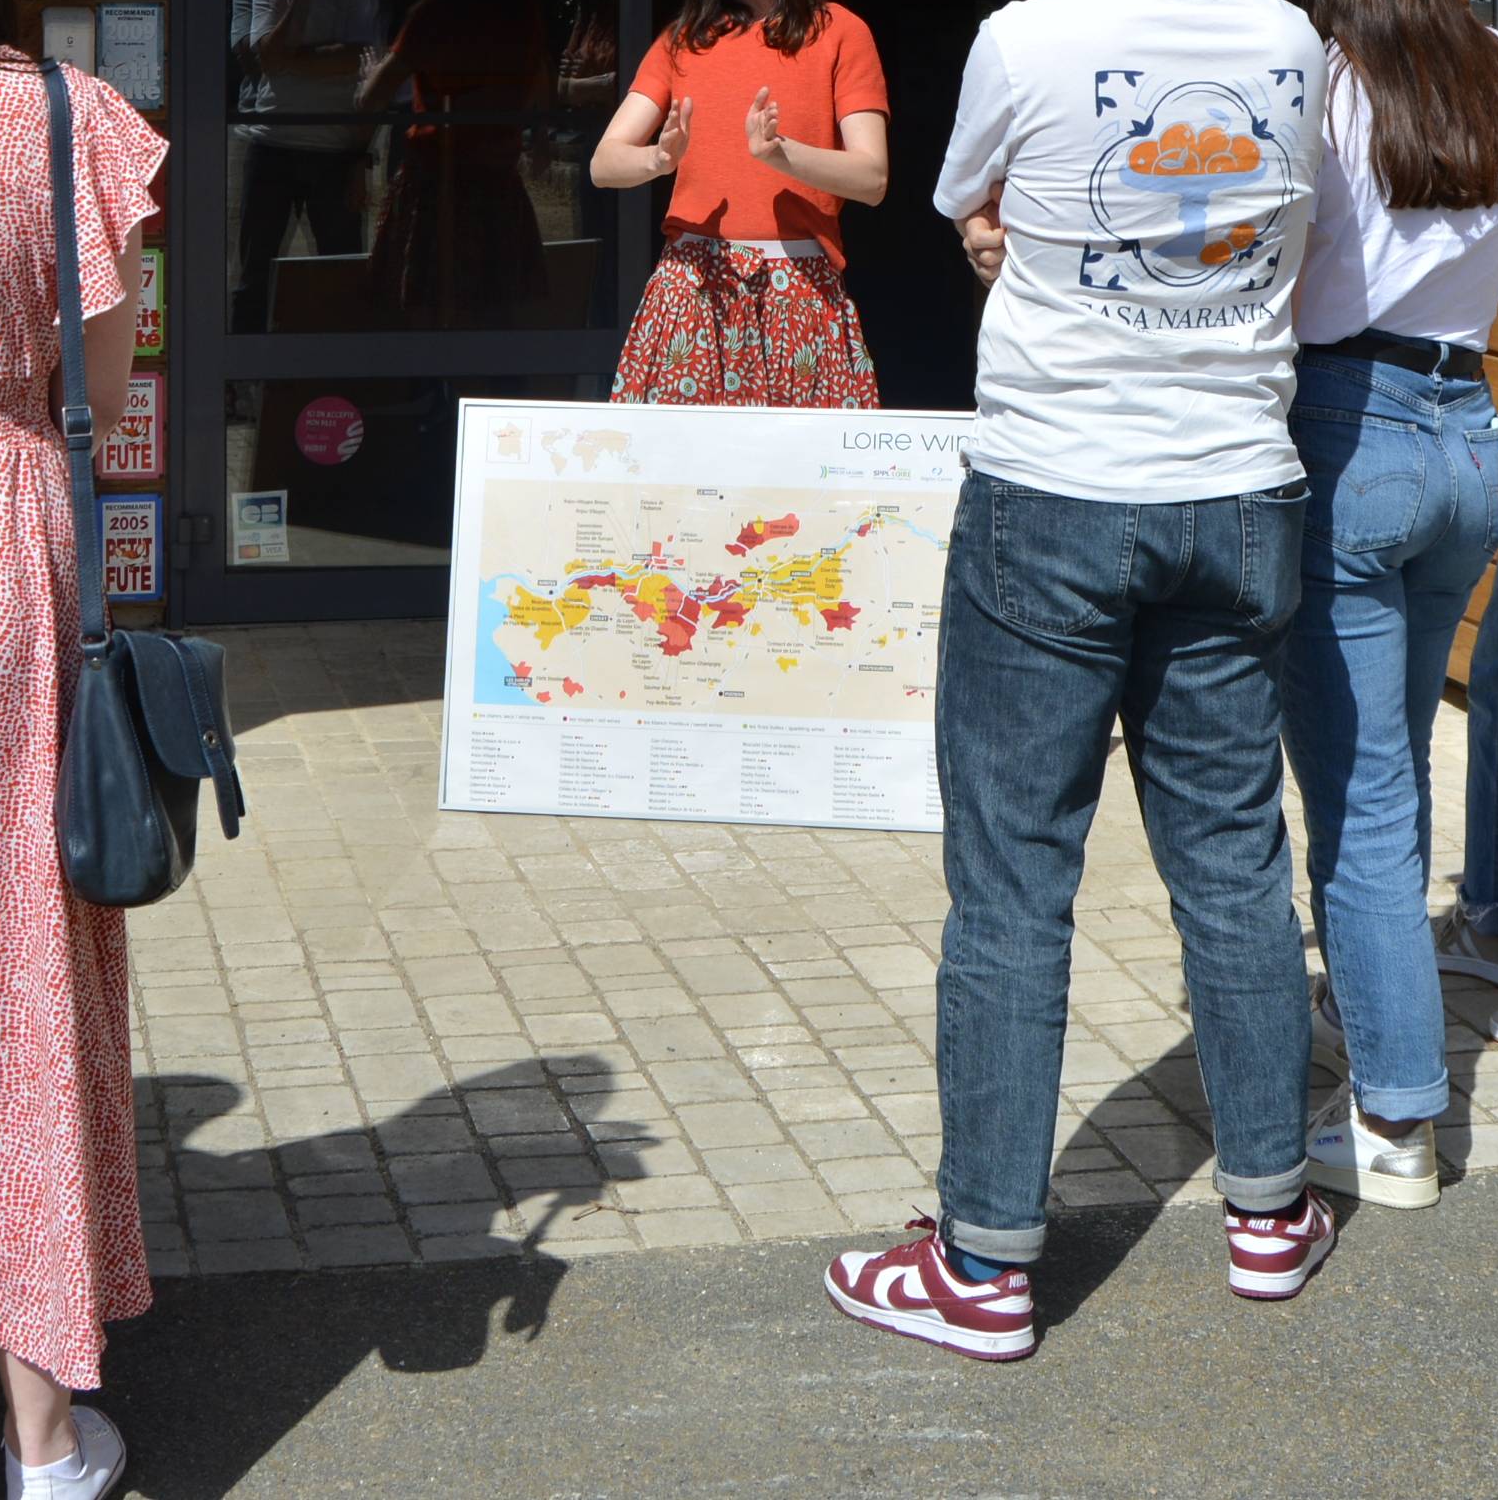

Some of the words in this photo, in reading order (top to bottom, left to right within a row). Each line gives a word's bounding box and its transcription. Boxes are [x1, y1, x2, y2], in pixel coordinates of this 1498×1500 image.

[105, 21, 155, 40] 2009
[1157, 301, 1277, 329] NARANJA
[109, 516, 149, 530] 2005
[1247, 1217, 1276, 1231] NIKE
